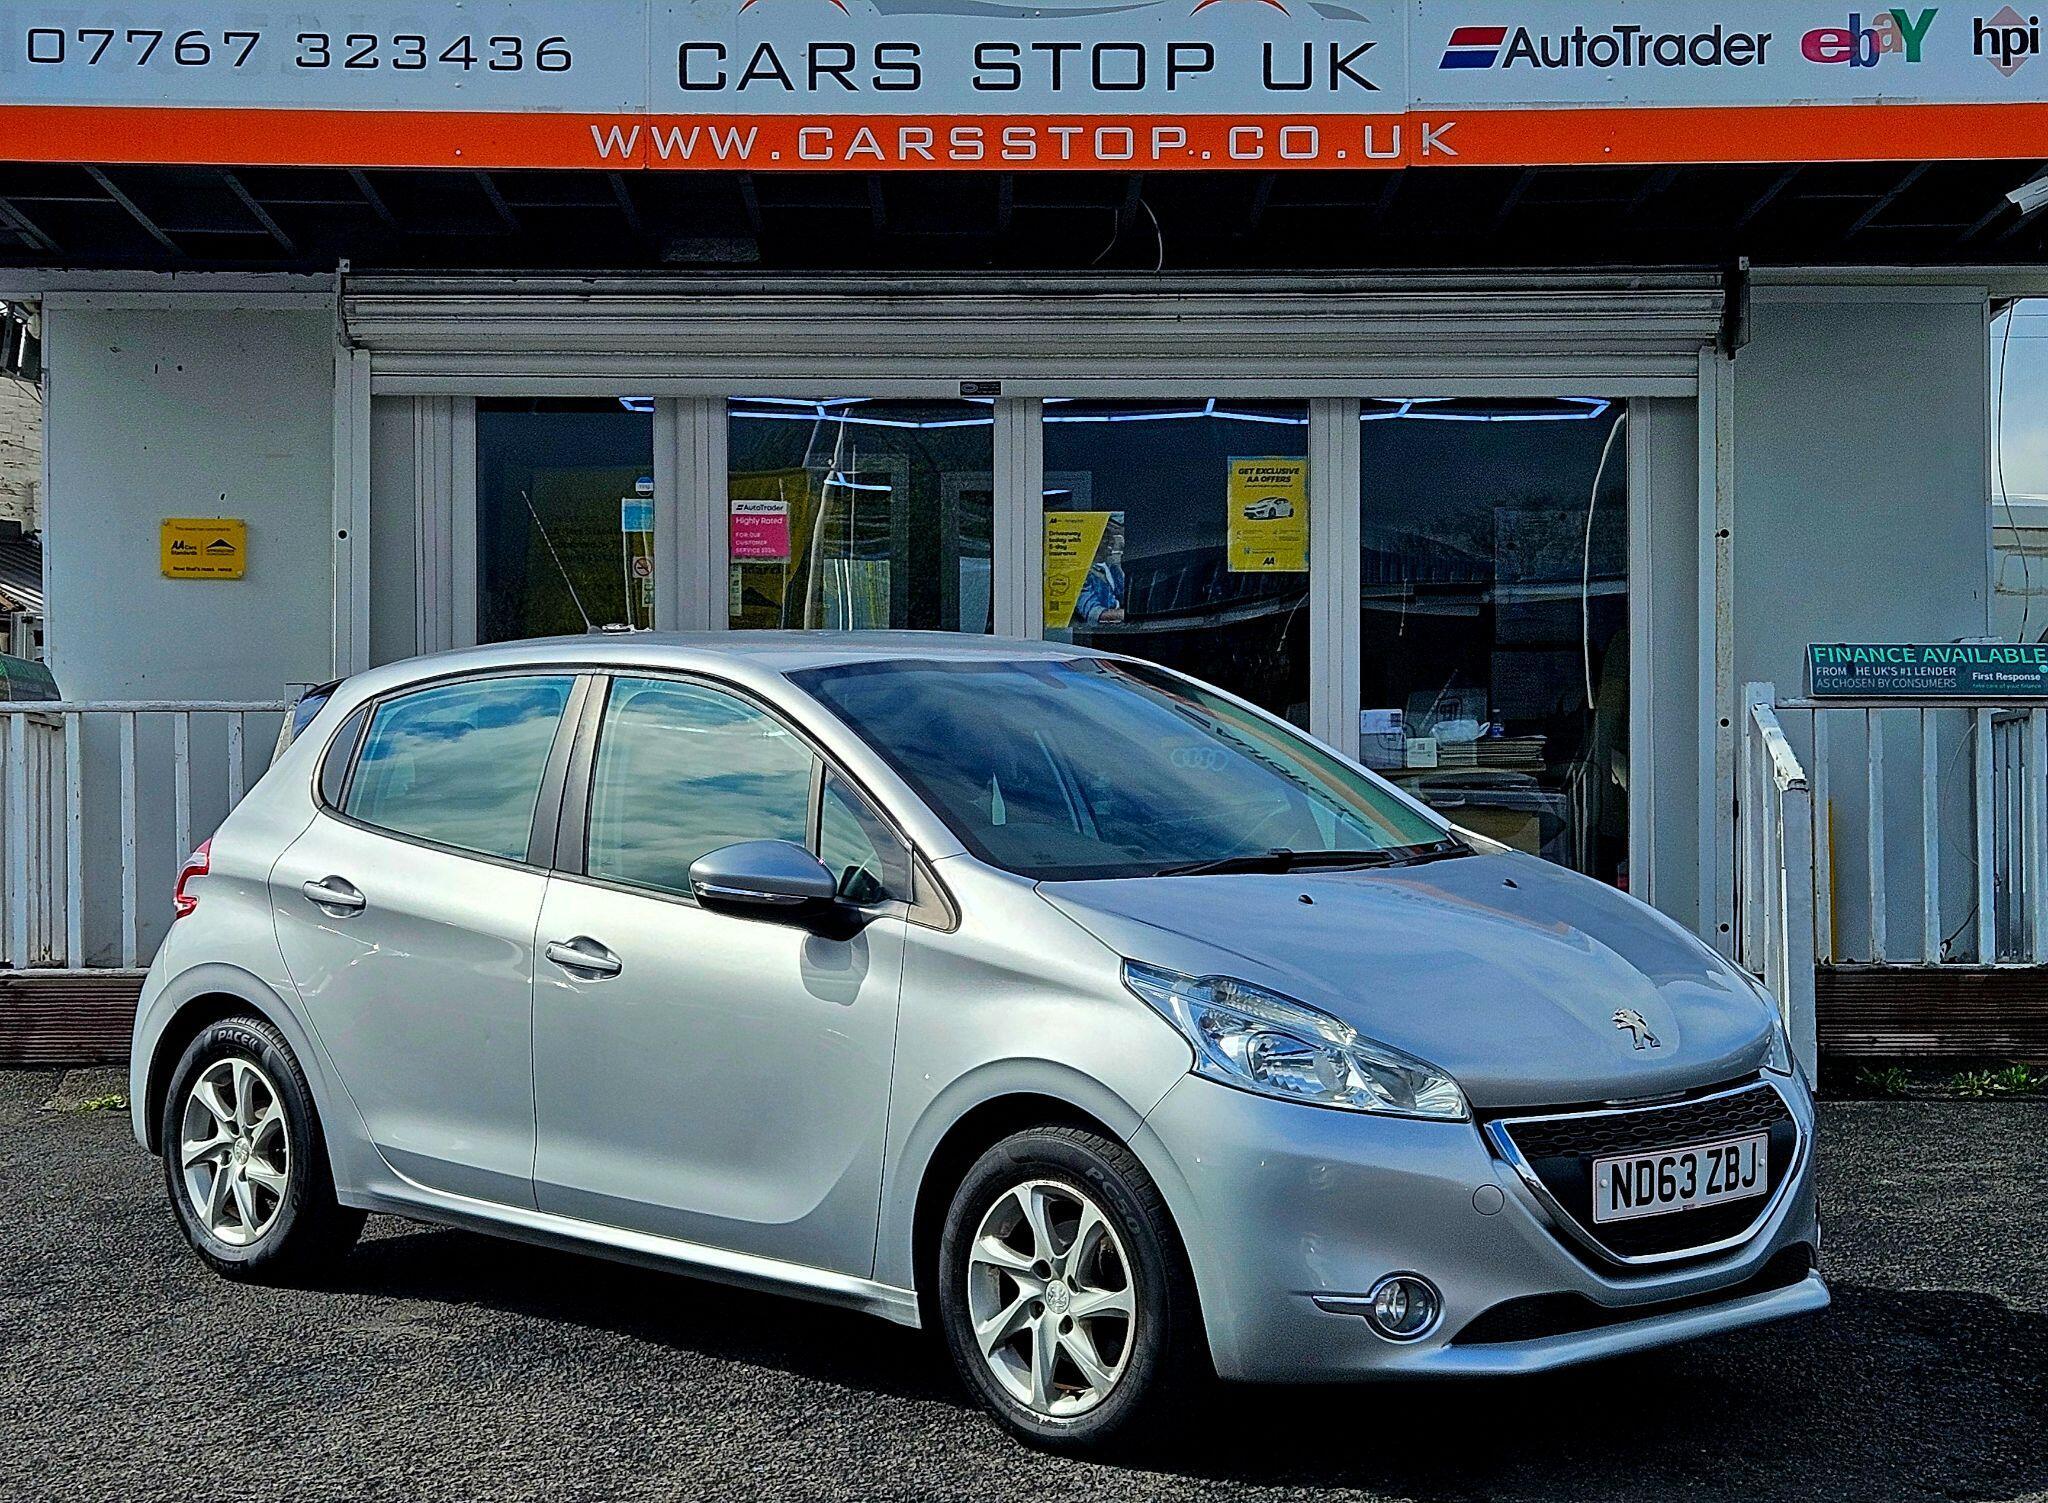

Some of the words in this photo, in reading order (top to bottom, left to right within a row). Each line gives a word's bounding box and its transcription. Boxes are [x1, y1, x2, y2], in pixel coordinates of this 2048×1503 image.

[1501, 24, 1772, 69] AutoTrader
[1973, 16, 2040, 67] hpi
[27, 29, 261, 68] 07767
[295, 33, 573, 72] 323436
[677, 42, 923, 92] CARS
[972, 42, 1217, 92] STOP
[1262, 42, 1381, 91] UK
[1238, 467, 1254, 475] GET
[1255, 467, 1300, 475] EXCLUSIVE
[1260, 475, 1291, 483] OFFERS
[735, 517, 760, 526] Highly
[170, 540, 185, 550] AA
[1263, 557, 1275, 565] AA
[1813, 647, 1917, 663] FINANCE
[1922, 647, 2048, 664] AVAILABLE
[1816, 666, 1847, 676] FROM
[1873, 666, 1898, 676] UK'S
[1900, 666, 1914, 676] #1
[1915, 666, 1957, 676] LENDER
[1972, 672, 1994, 681] First
[1995, 672, 2041, 682] Response
[1816, 679, 1831, 688] AS
[1832, 679, 1875, 688] CHOSEN
[1877, 679, 1891, 688] BY
[1892, 679, 1957, 688] CONSUMERS
[1611, 1153, 1697, 1211] ND63
[1705, 1142, 1757, 1196] ZBJ
